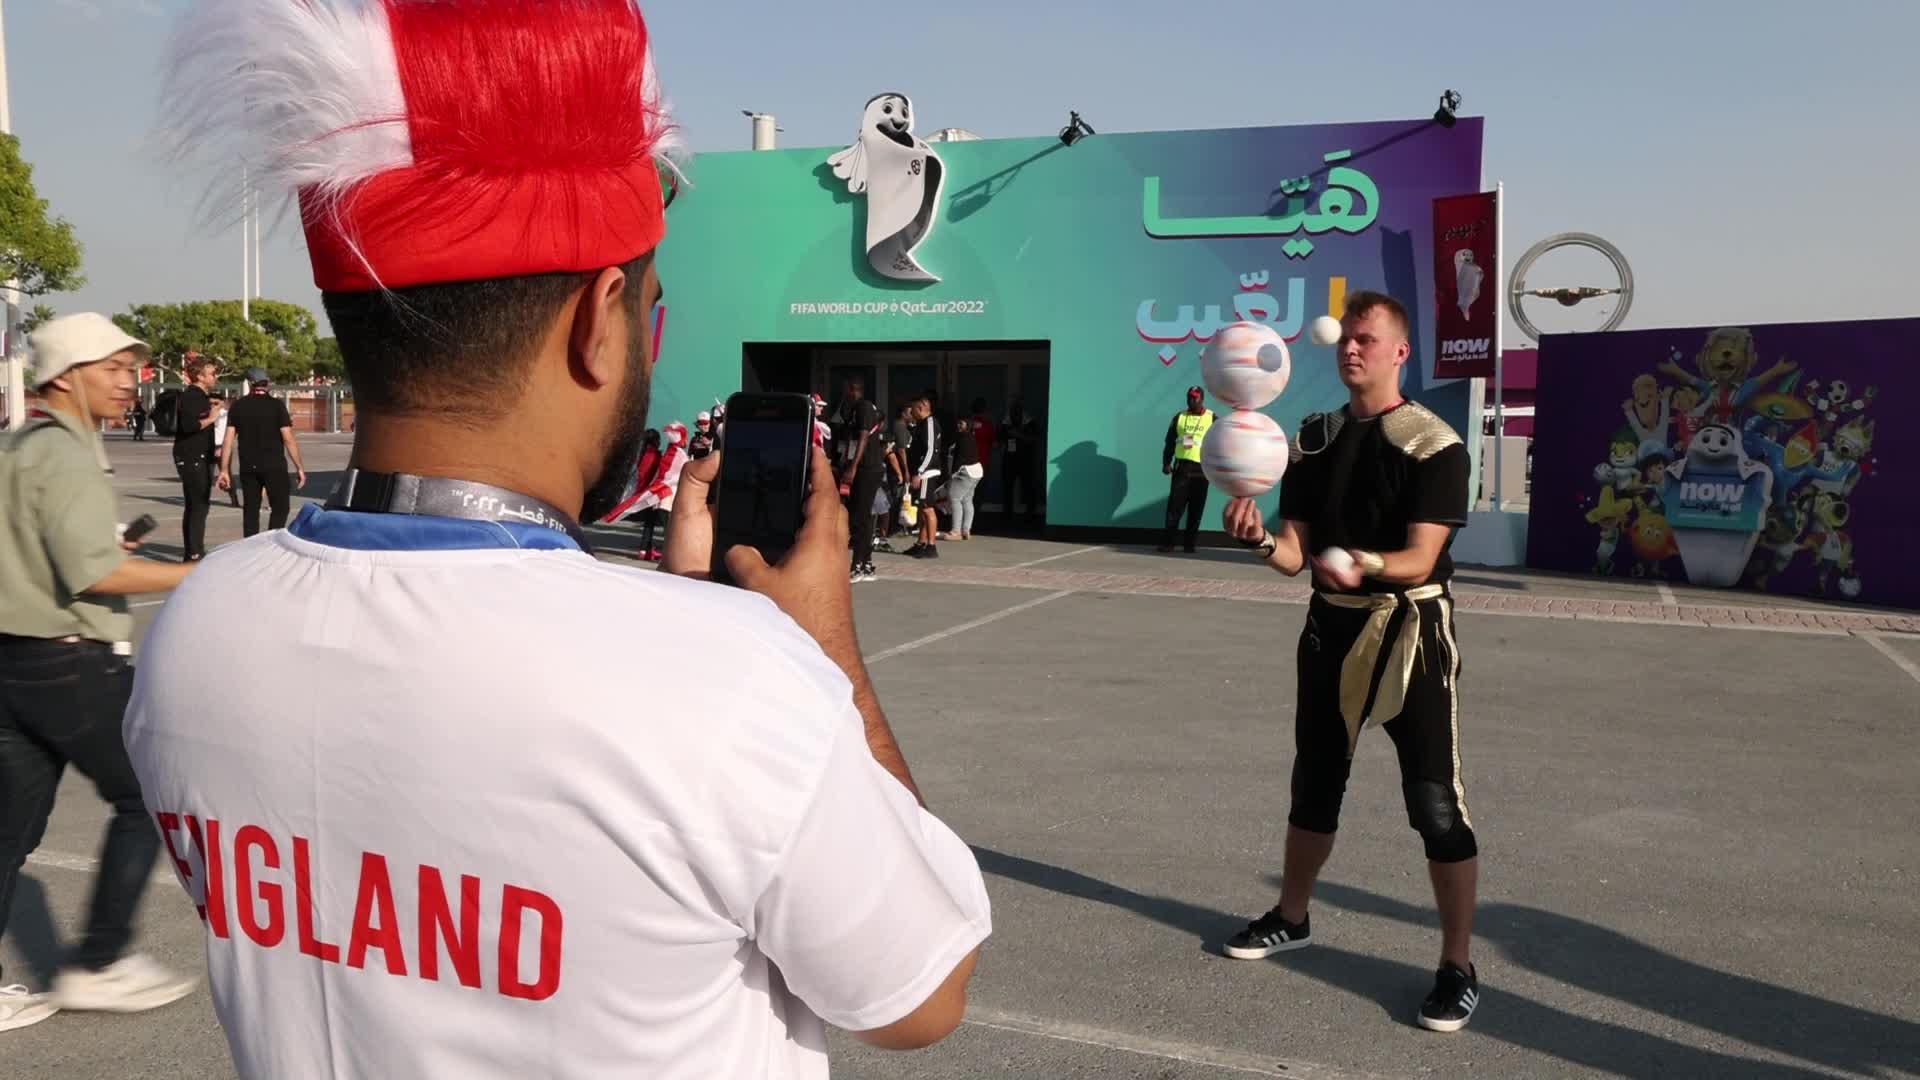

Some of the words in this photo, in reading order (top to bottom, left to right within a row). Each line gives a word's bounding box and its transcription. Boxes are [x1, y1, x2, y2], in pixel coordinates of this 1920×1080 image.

[790, 302, 817, 314] FIFA
[817, 302, 862, 314] WORLD
[863, 301, 889, 314] CUP
[1680, 482, 1745, 502] now
